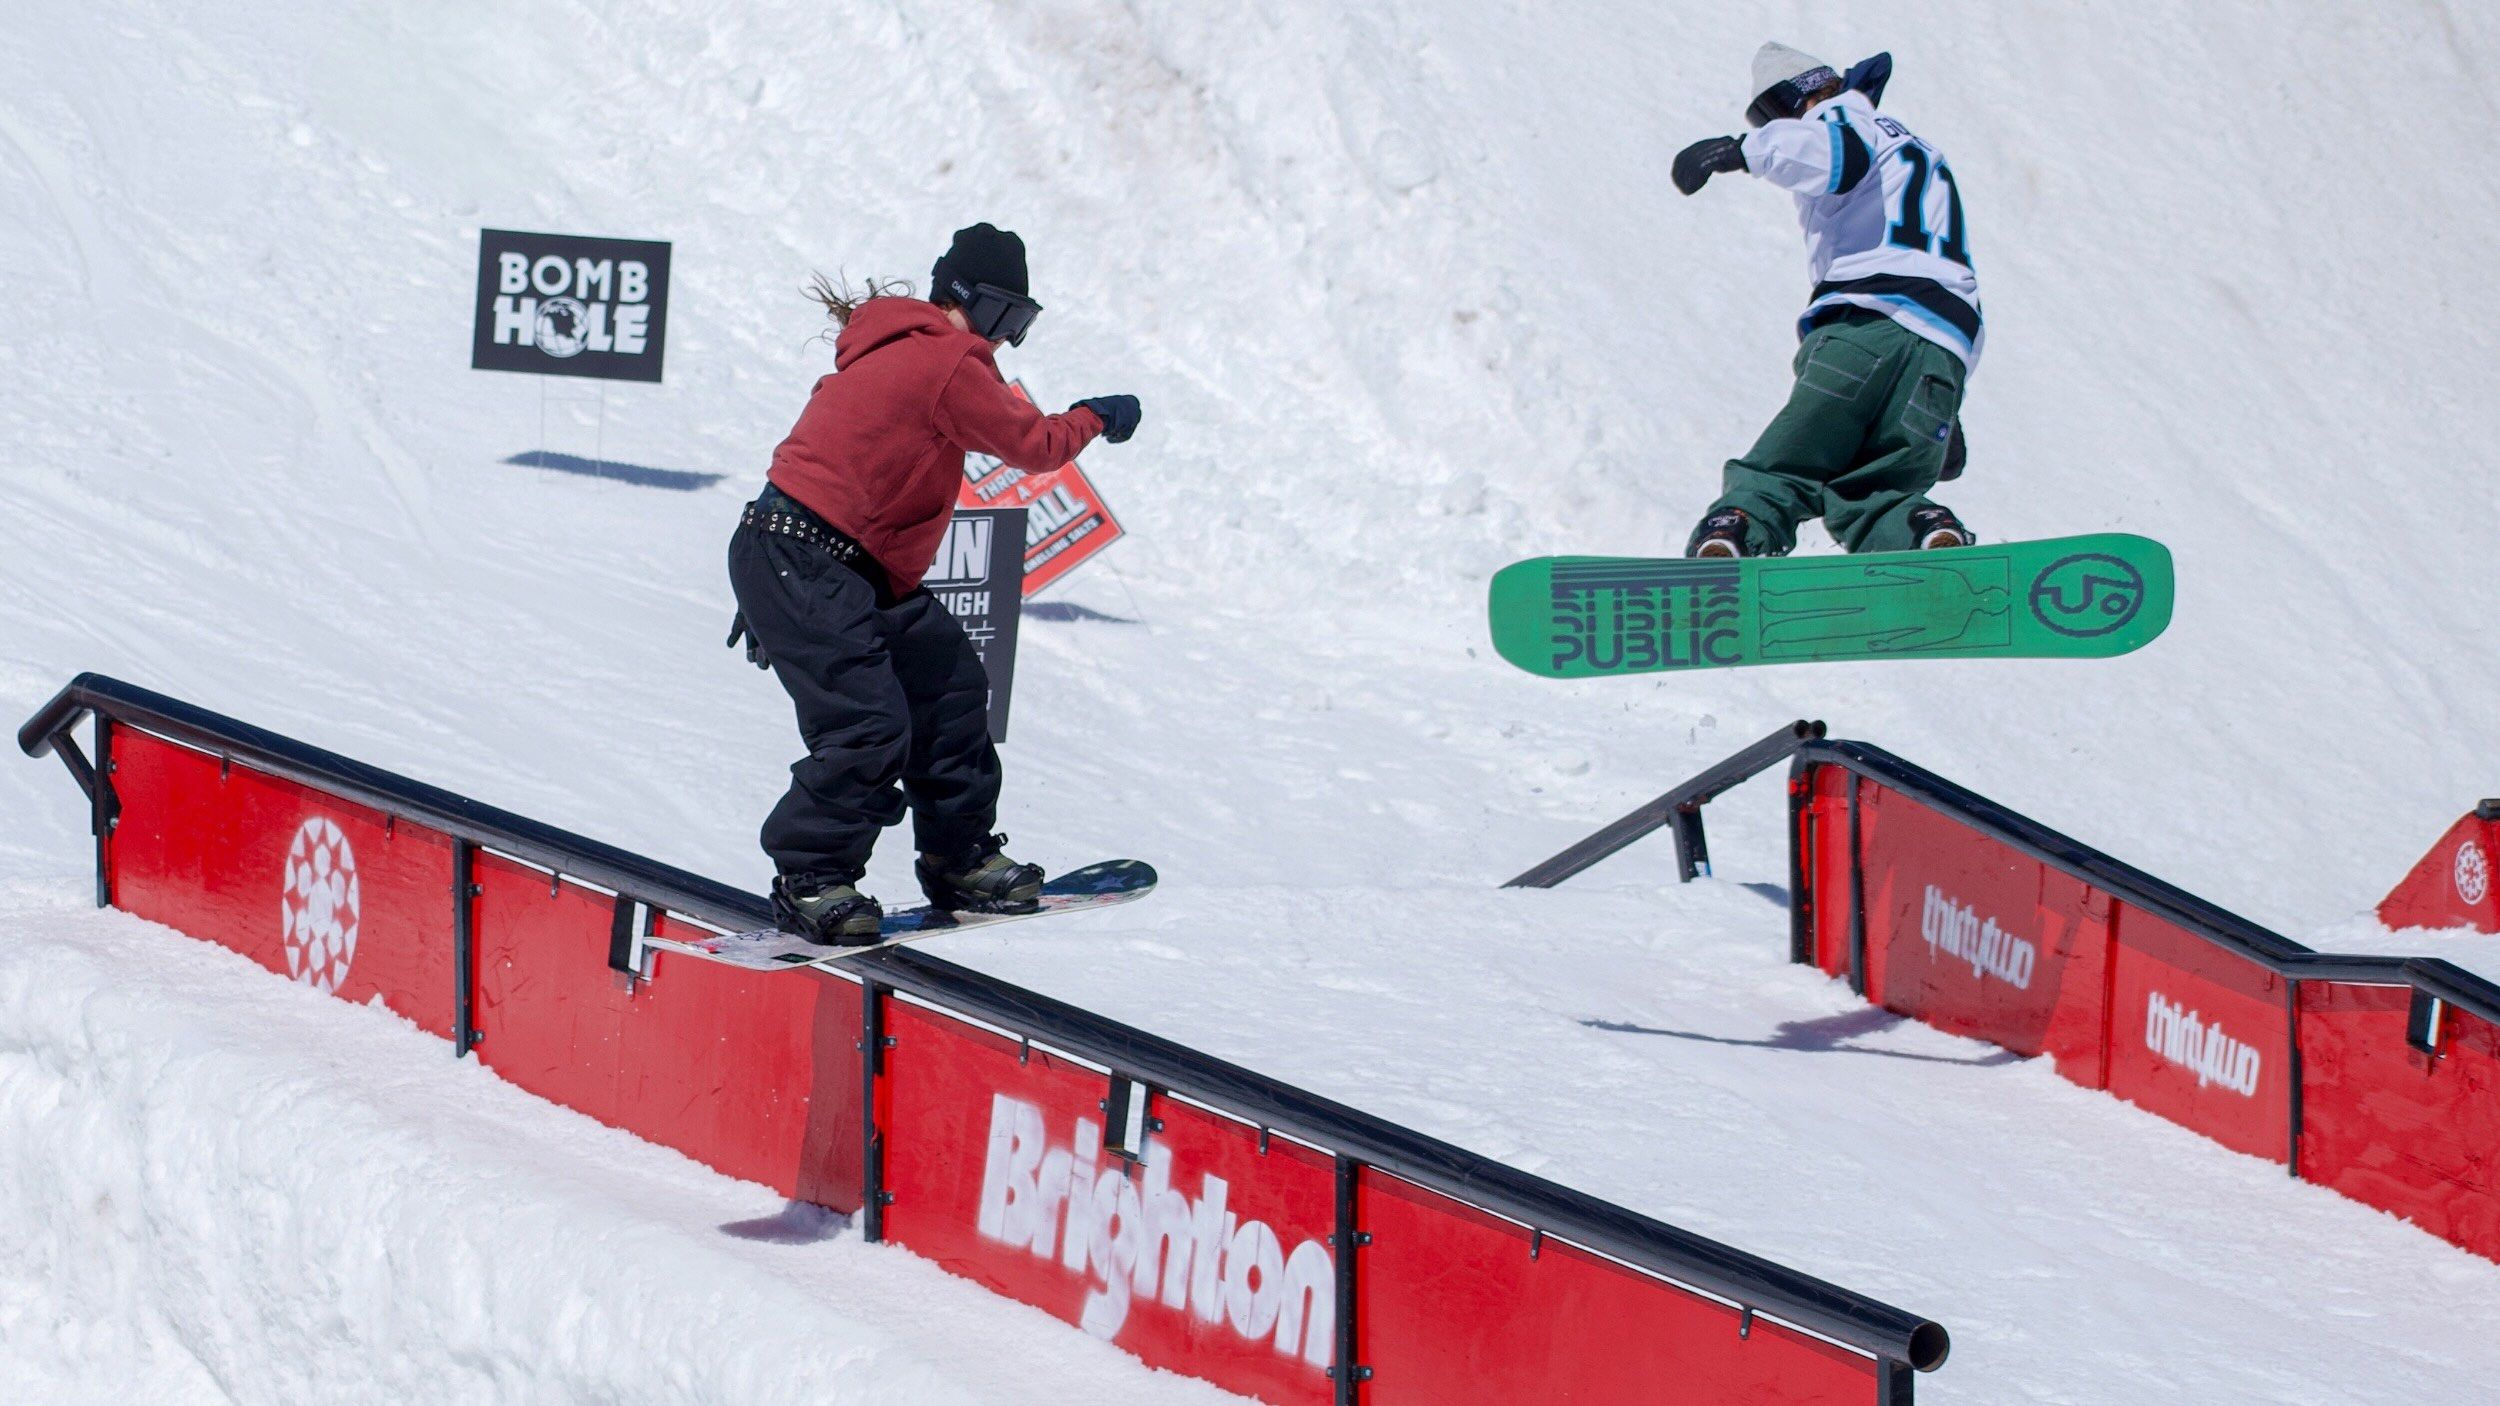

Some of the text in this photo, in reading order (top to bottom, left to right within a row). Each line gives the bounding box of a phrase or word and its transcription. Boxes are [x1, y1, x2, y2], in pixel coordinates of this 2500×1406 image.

[1889, 140, 1974, 271] 11
[498, 251, 649, 303] BOMB
[493, 295, 650, 358] HOLE
[1016, 485, 1032, 500] A
[921, 520, 990, 581] UN
[1066, 516, 1099, 544] SALTS
[934, 591, 991, 616] UGH
[1551, 628, 1742, 671] PUBLIC
[1922, 884, 2036, 990] thirtytwo
[2145, 991, 2261, 1098] thirtytwo
[977, 1093, 1336, 1369] Brighton
